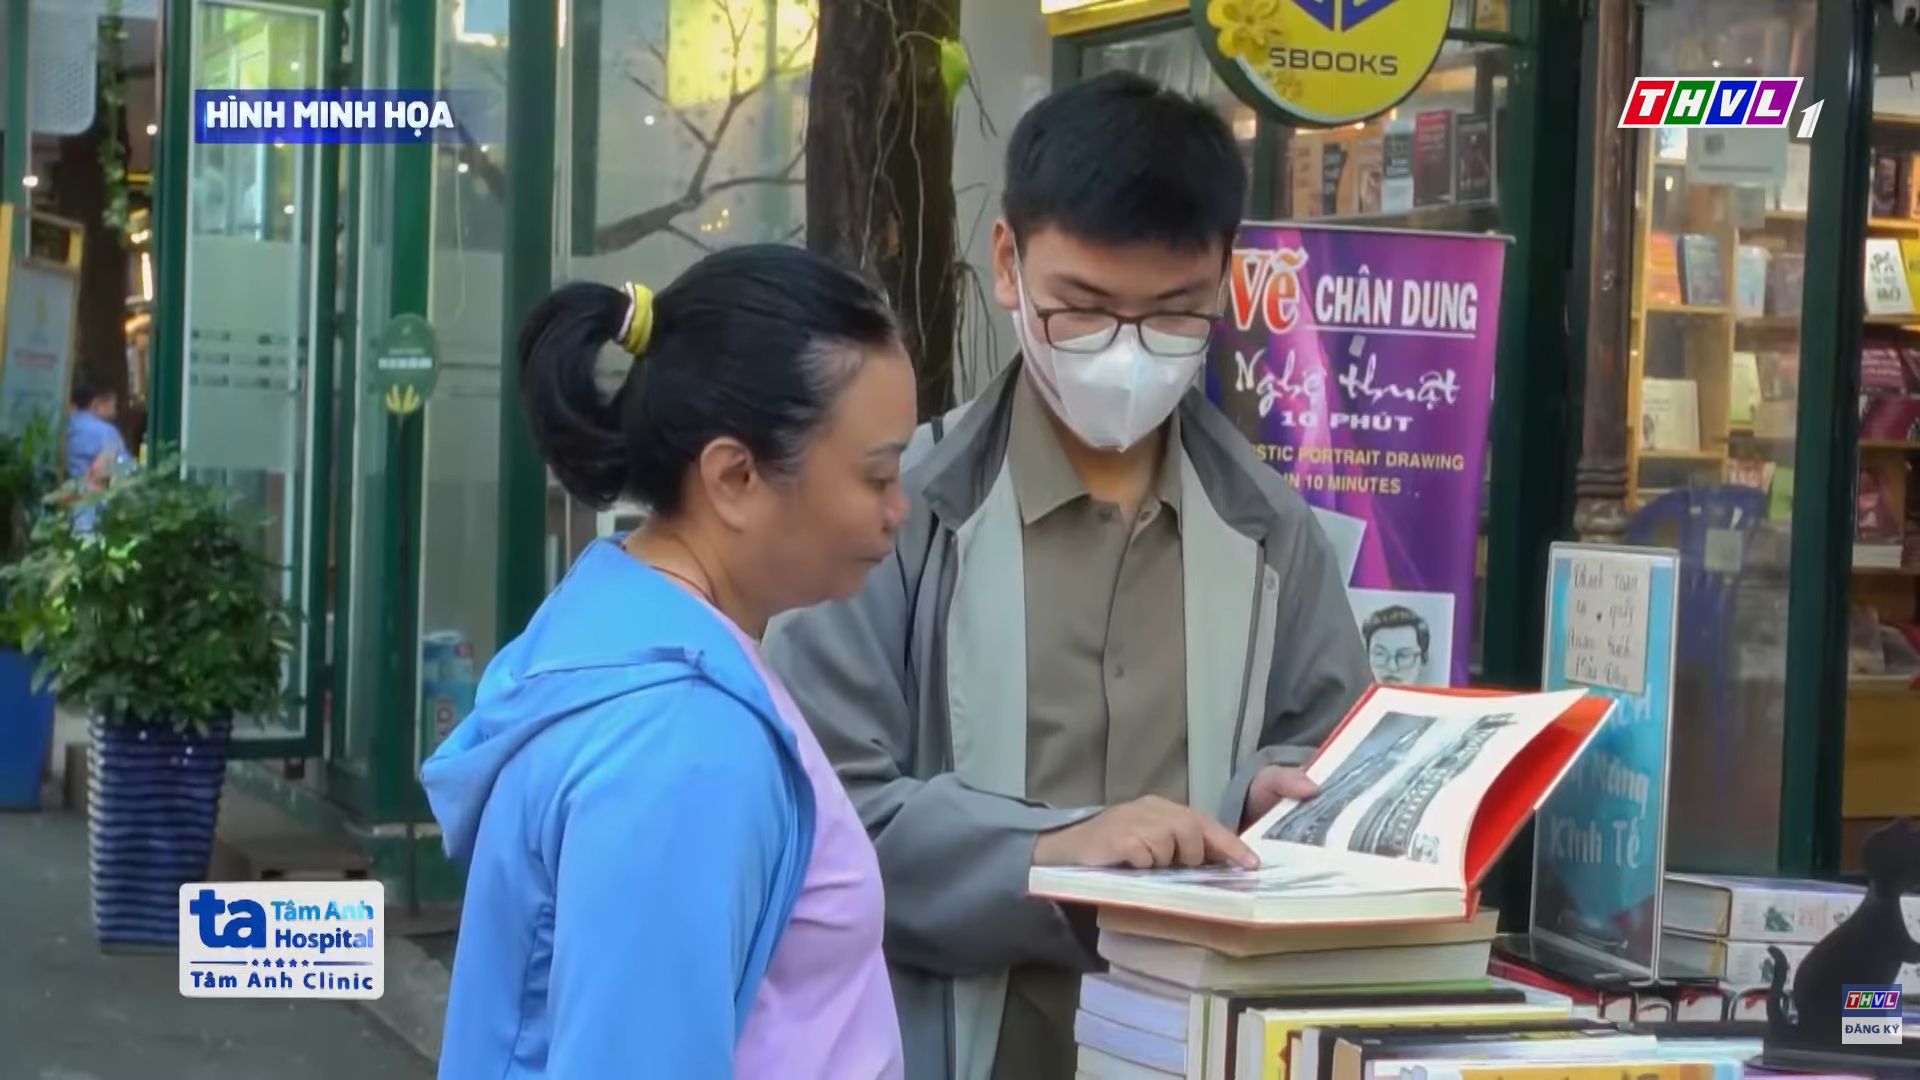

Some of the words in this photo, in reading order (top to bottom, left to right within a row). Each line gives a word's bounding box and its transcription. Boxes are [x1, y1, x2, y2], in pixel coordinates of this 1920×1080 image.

[1269, 47, 1398, 76] SBOOKS
[1230, 247, 1309, 334] Vẽ
[1315, 264, 1393, 326] CHÂN
[1401, 280, 1478, 330] DUNG
[1339, 353, 1461, 410] thuật
[1280, 410, 1318, 428] 10
[1330, 410, 1413, 432] PHÚT
[1251, 443, 1293, 462] ISTIC
[1299, 446, 1380, 467] PORTRAIT
[1386, 450, 1464, 471] DRAWING
[1306, 472, 1323, 491] 10
[1327, 474, 1401, 495] MINUTES
